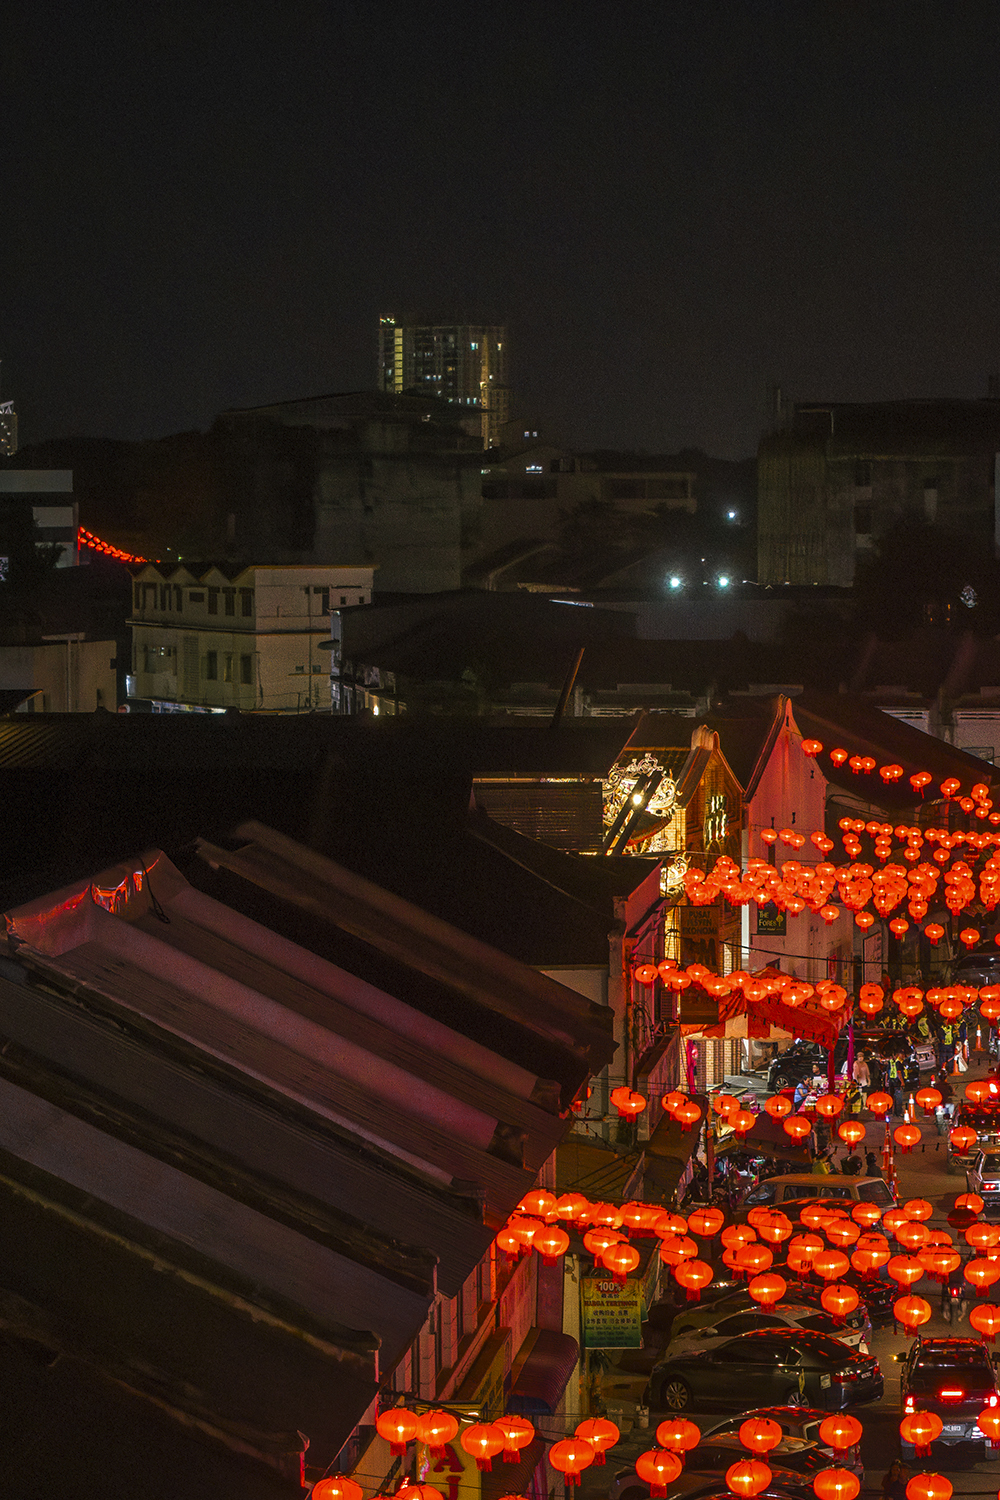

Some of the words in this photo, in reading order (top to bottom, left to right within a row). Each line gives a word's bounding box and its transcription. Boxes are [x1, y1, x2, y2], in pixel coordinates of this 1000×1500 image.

[688, 910, 711, 919] PUSAT
[758, 910, 769, 919] THE
[682, 927, 718, 935] EKONOMI
